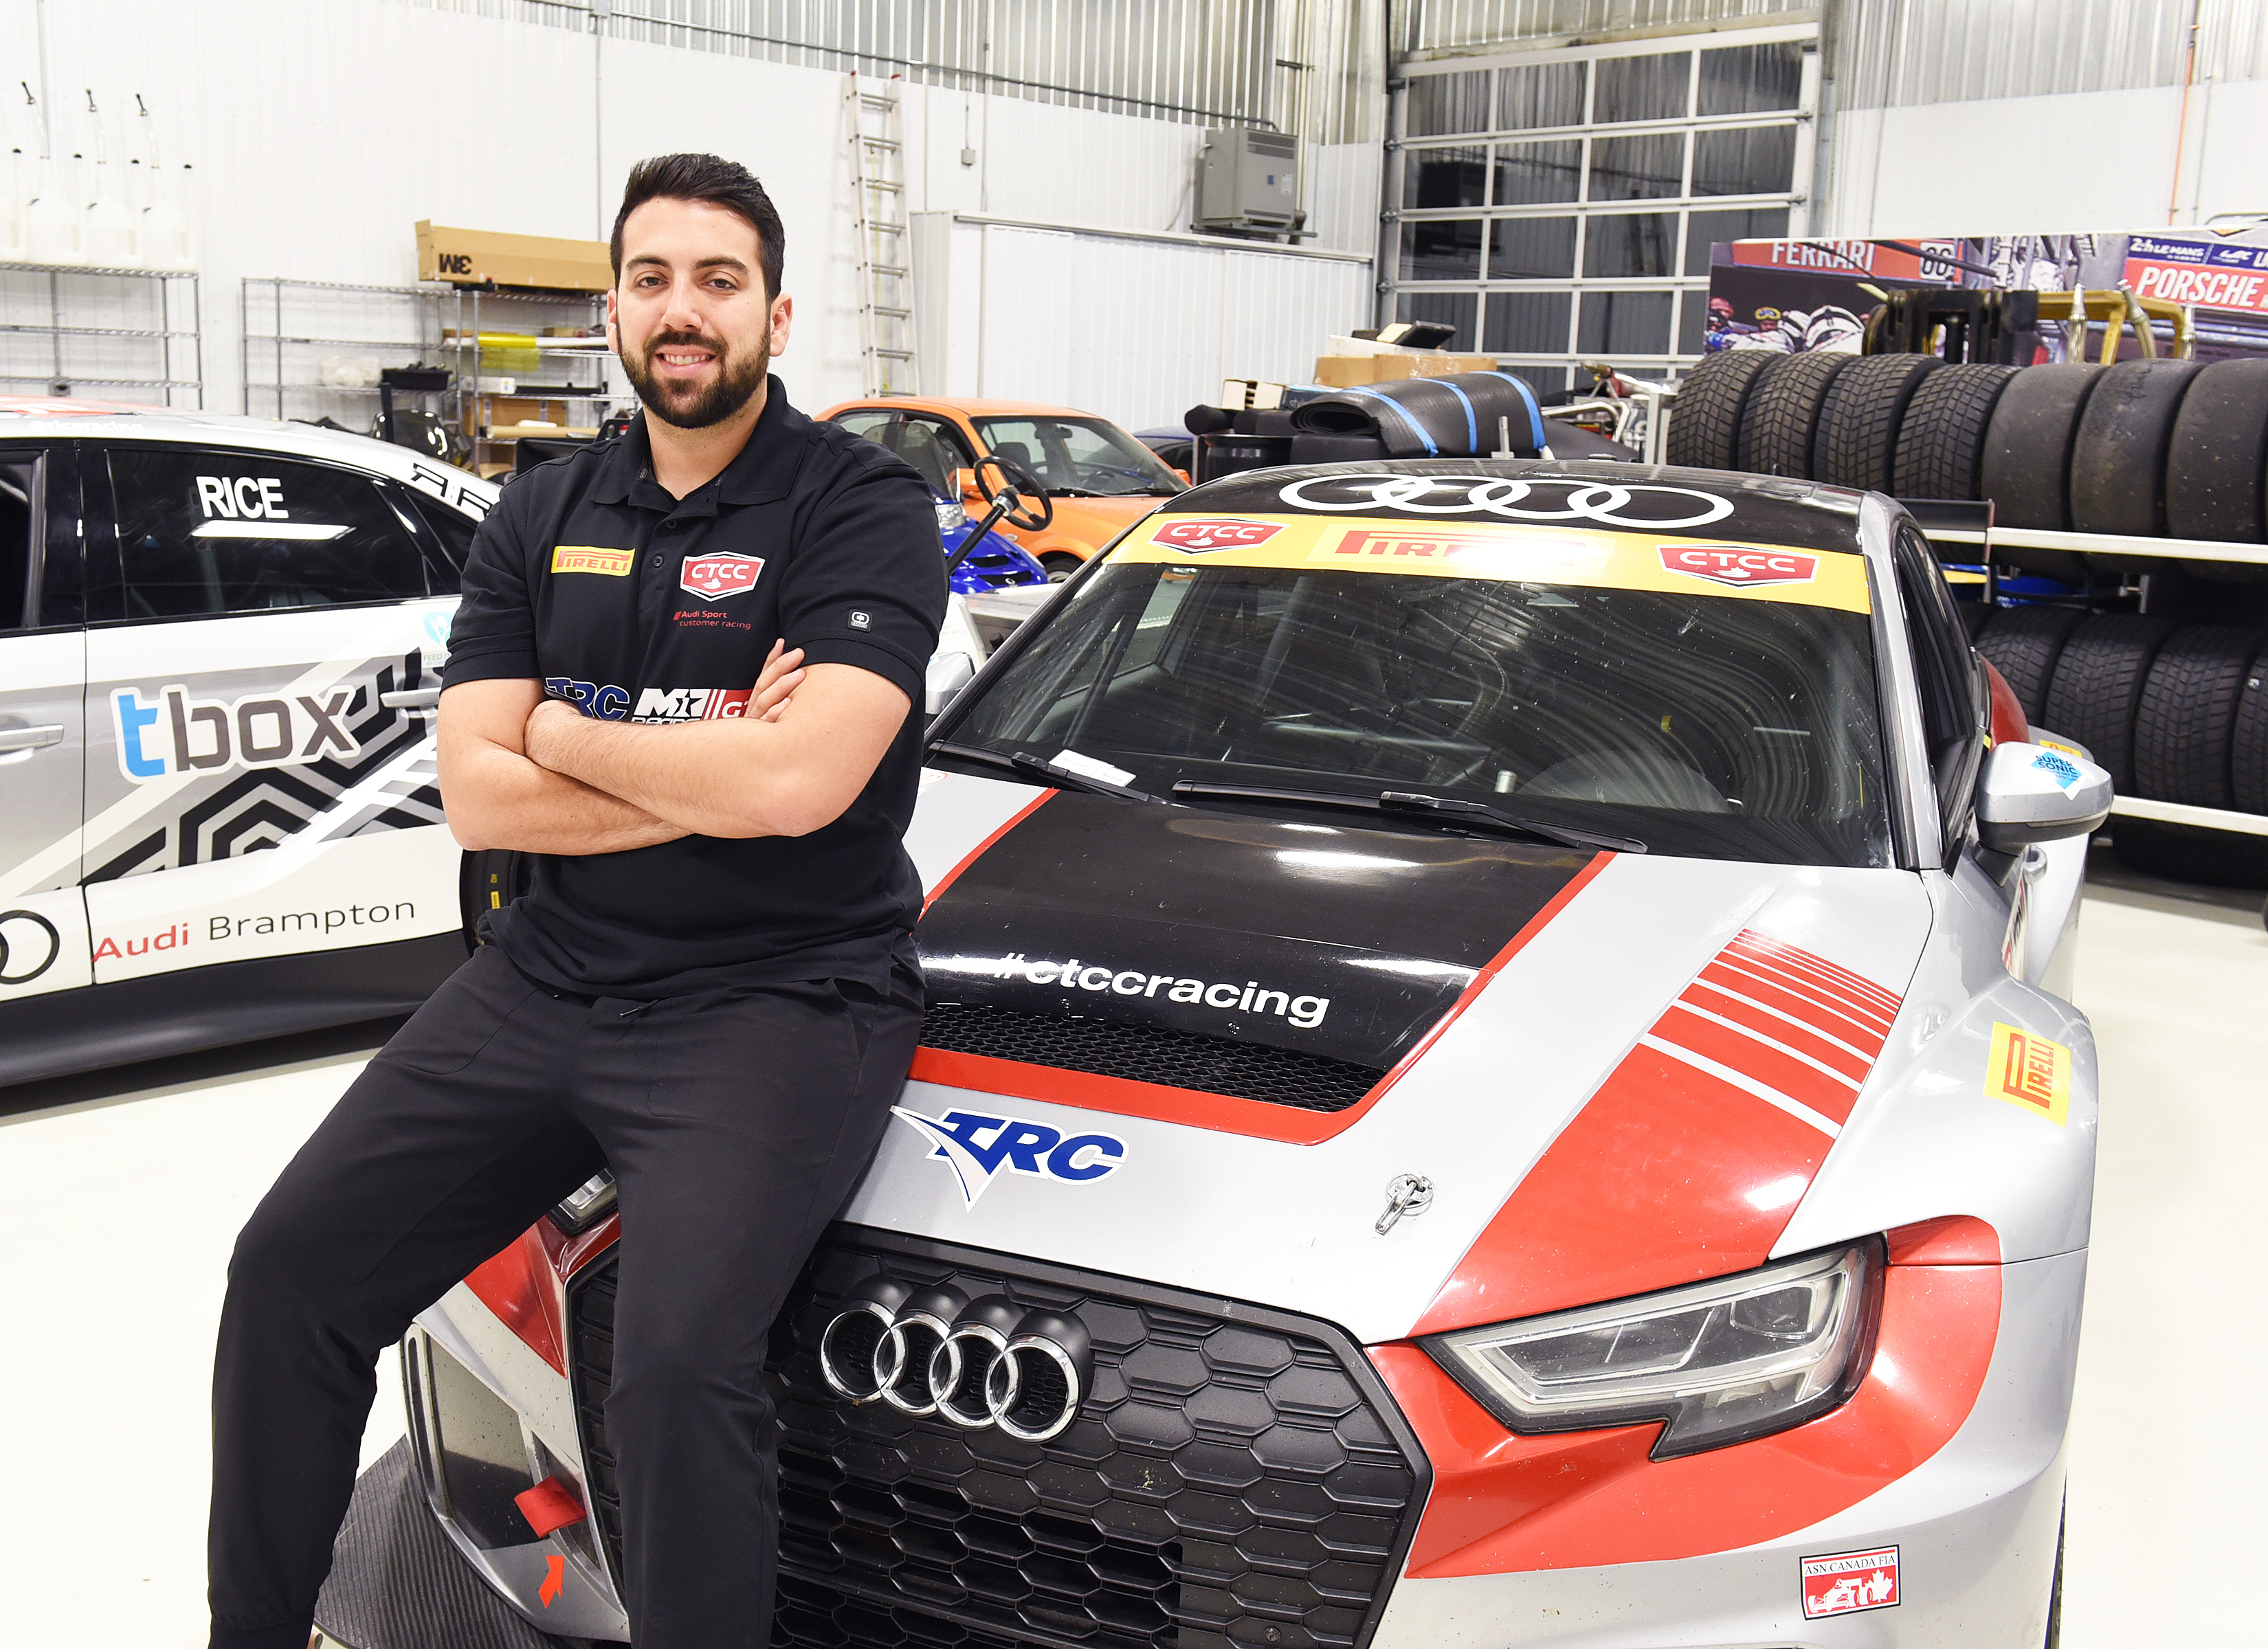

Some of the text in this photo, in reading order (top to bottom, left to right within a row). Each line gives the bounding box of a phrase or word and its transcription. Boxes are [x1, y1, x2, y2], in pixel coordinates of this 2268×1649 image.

[438, 253, 472, 275] 3M
[1771, 240, 1876, 272] FERRARI
[2135, 266, 2265, 307] PORSCHE
[196, 476, 289, 519] RICE
[1170, 525, 1265, 539] CTCC
[556, 550, 631, 572] PIRELLI
[691, 563, 750, 580] CTCC
[1679, 551, 1796, 572] CTCC
[702, 610, 728, 619] Sport
[722, 620, 751, 631] racing
[544, 677, 630, 721] TRC
[118, 688, 355, 778] tbox
[2036, 755, 2074, 768] SUPER
[2038, 761, 2078, 775] SONIC
[91, 900, 415, 962] Audi Brampton
[993, 952, 1331, 1029] #ctccracing
[2003, 1033, 2054, 1110] PIRELLI
[935, 1110, 1127, 1182] TRC
[1805, 1555, 1895, 1575] ASN CANADA FIA
